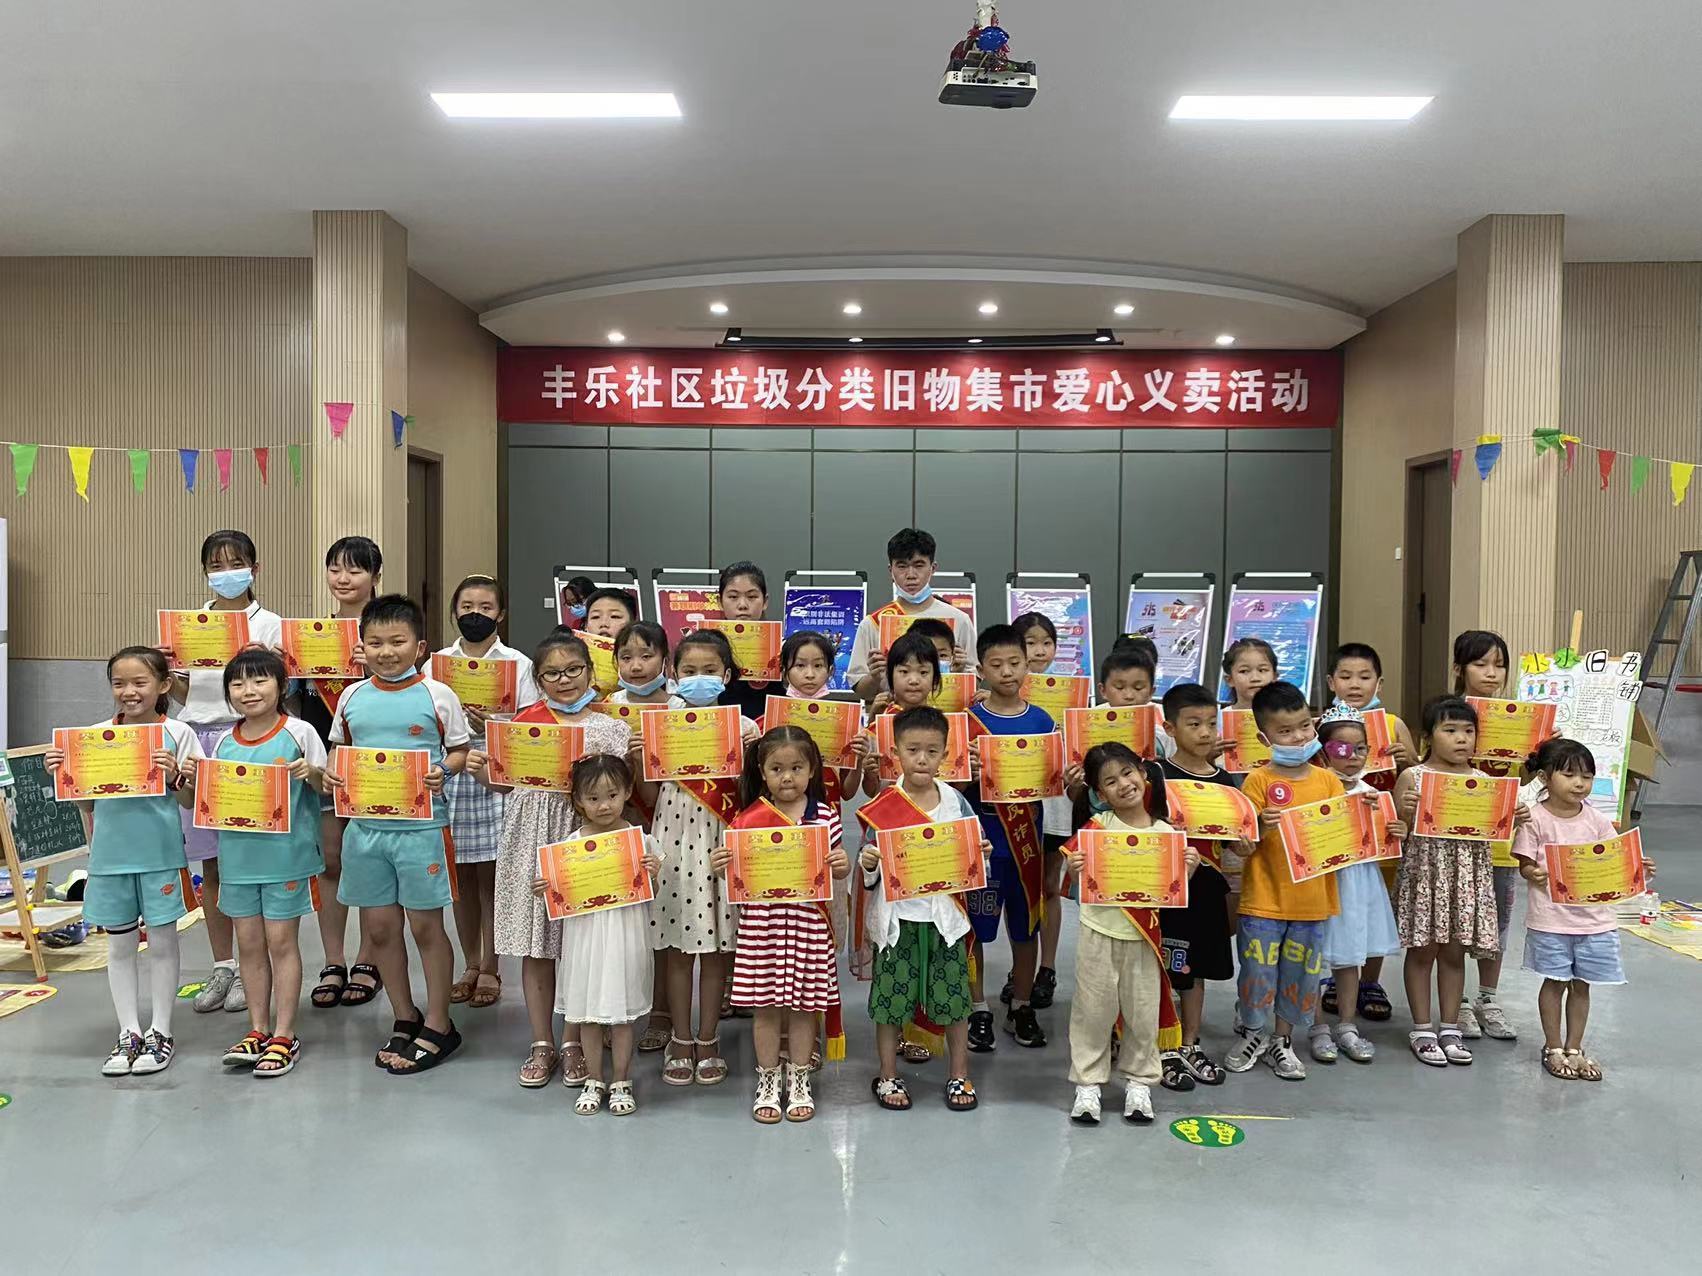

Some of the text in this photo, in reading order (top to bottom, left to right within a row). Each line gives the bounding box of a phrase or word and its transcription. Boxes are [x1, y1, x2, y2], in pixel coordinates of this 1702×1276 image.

[541, 364, 1310, 413] 丰乐社区垃圾分类旧物集市爱心义卖活动
[1275, 787, 1285, 800] 9
[1007, 803, 1036, 865] 反诈员
